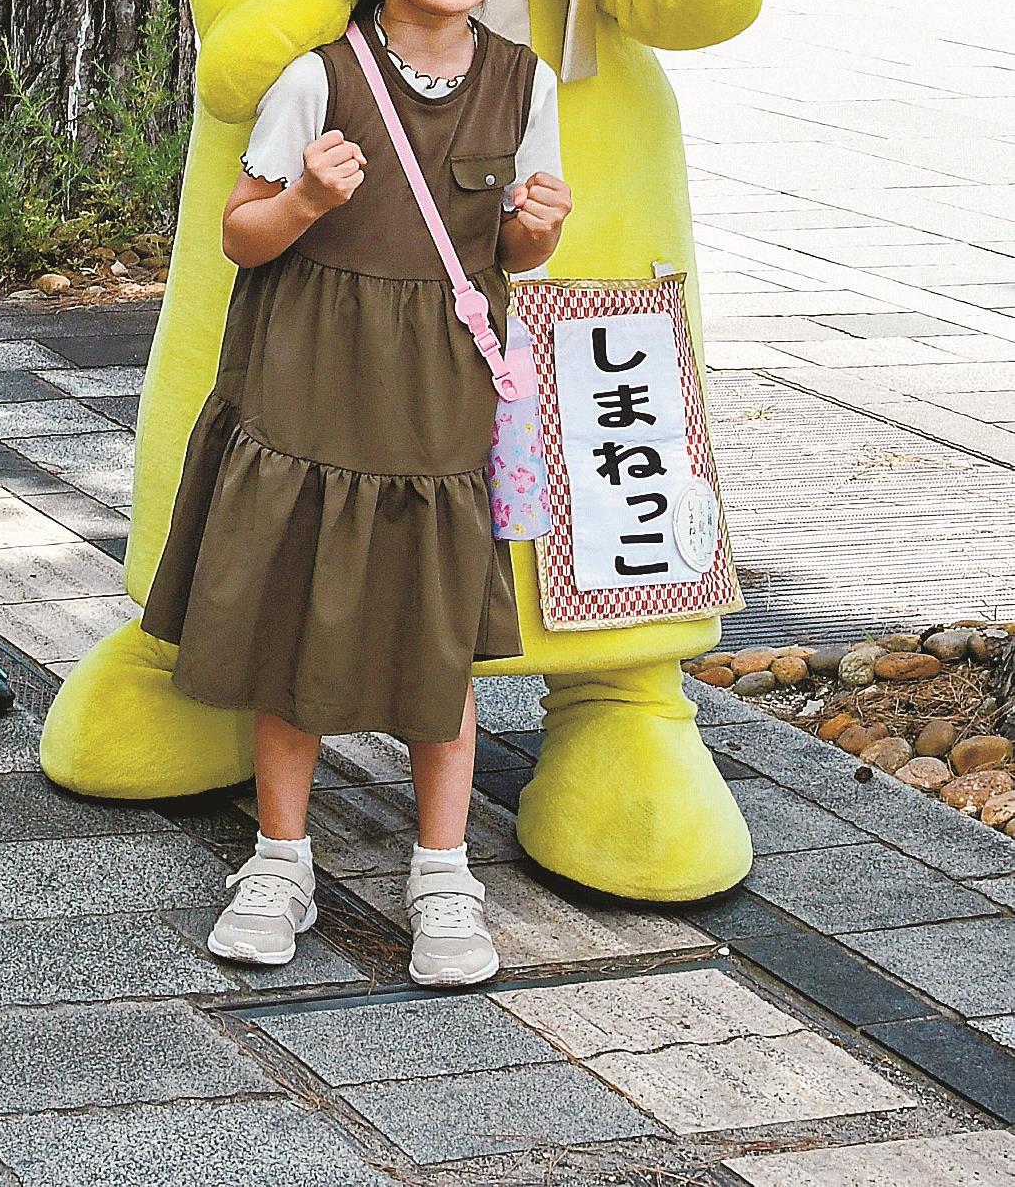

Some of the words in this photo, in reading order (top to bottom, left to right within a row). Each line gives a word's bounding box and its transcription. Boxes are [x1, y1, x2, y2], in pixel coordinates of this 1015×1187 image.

[591, 326, 668, 576] しまねっこ
